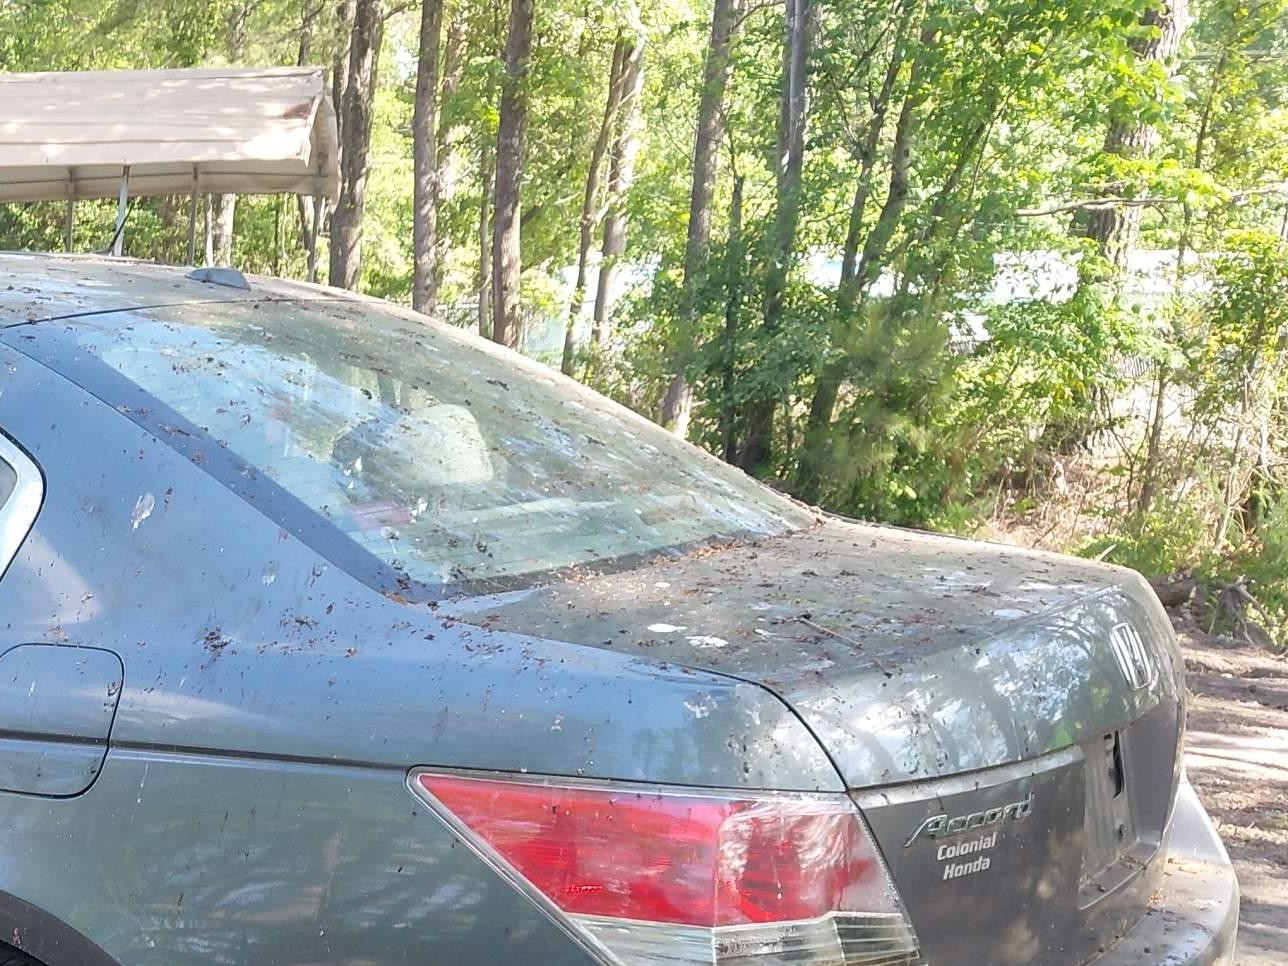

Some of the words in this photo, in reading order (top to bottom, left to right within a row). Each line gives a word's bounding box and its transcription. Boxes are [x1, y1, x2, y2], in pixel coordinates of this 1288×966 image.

[903, 791, 1036, 848] Accord
[937, 831, 999, 861] Colonial
[943, 856, 991, 880] Honda
